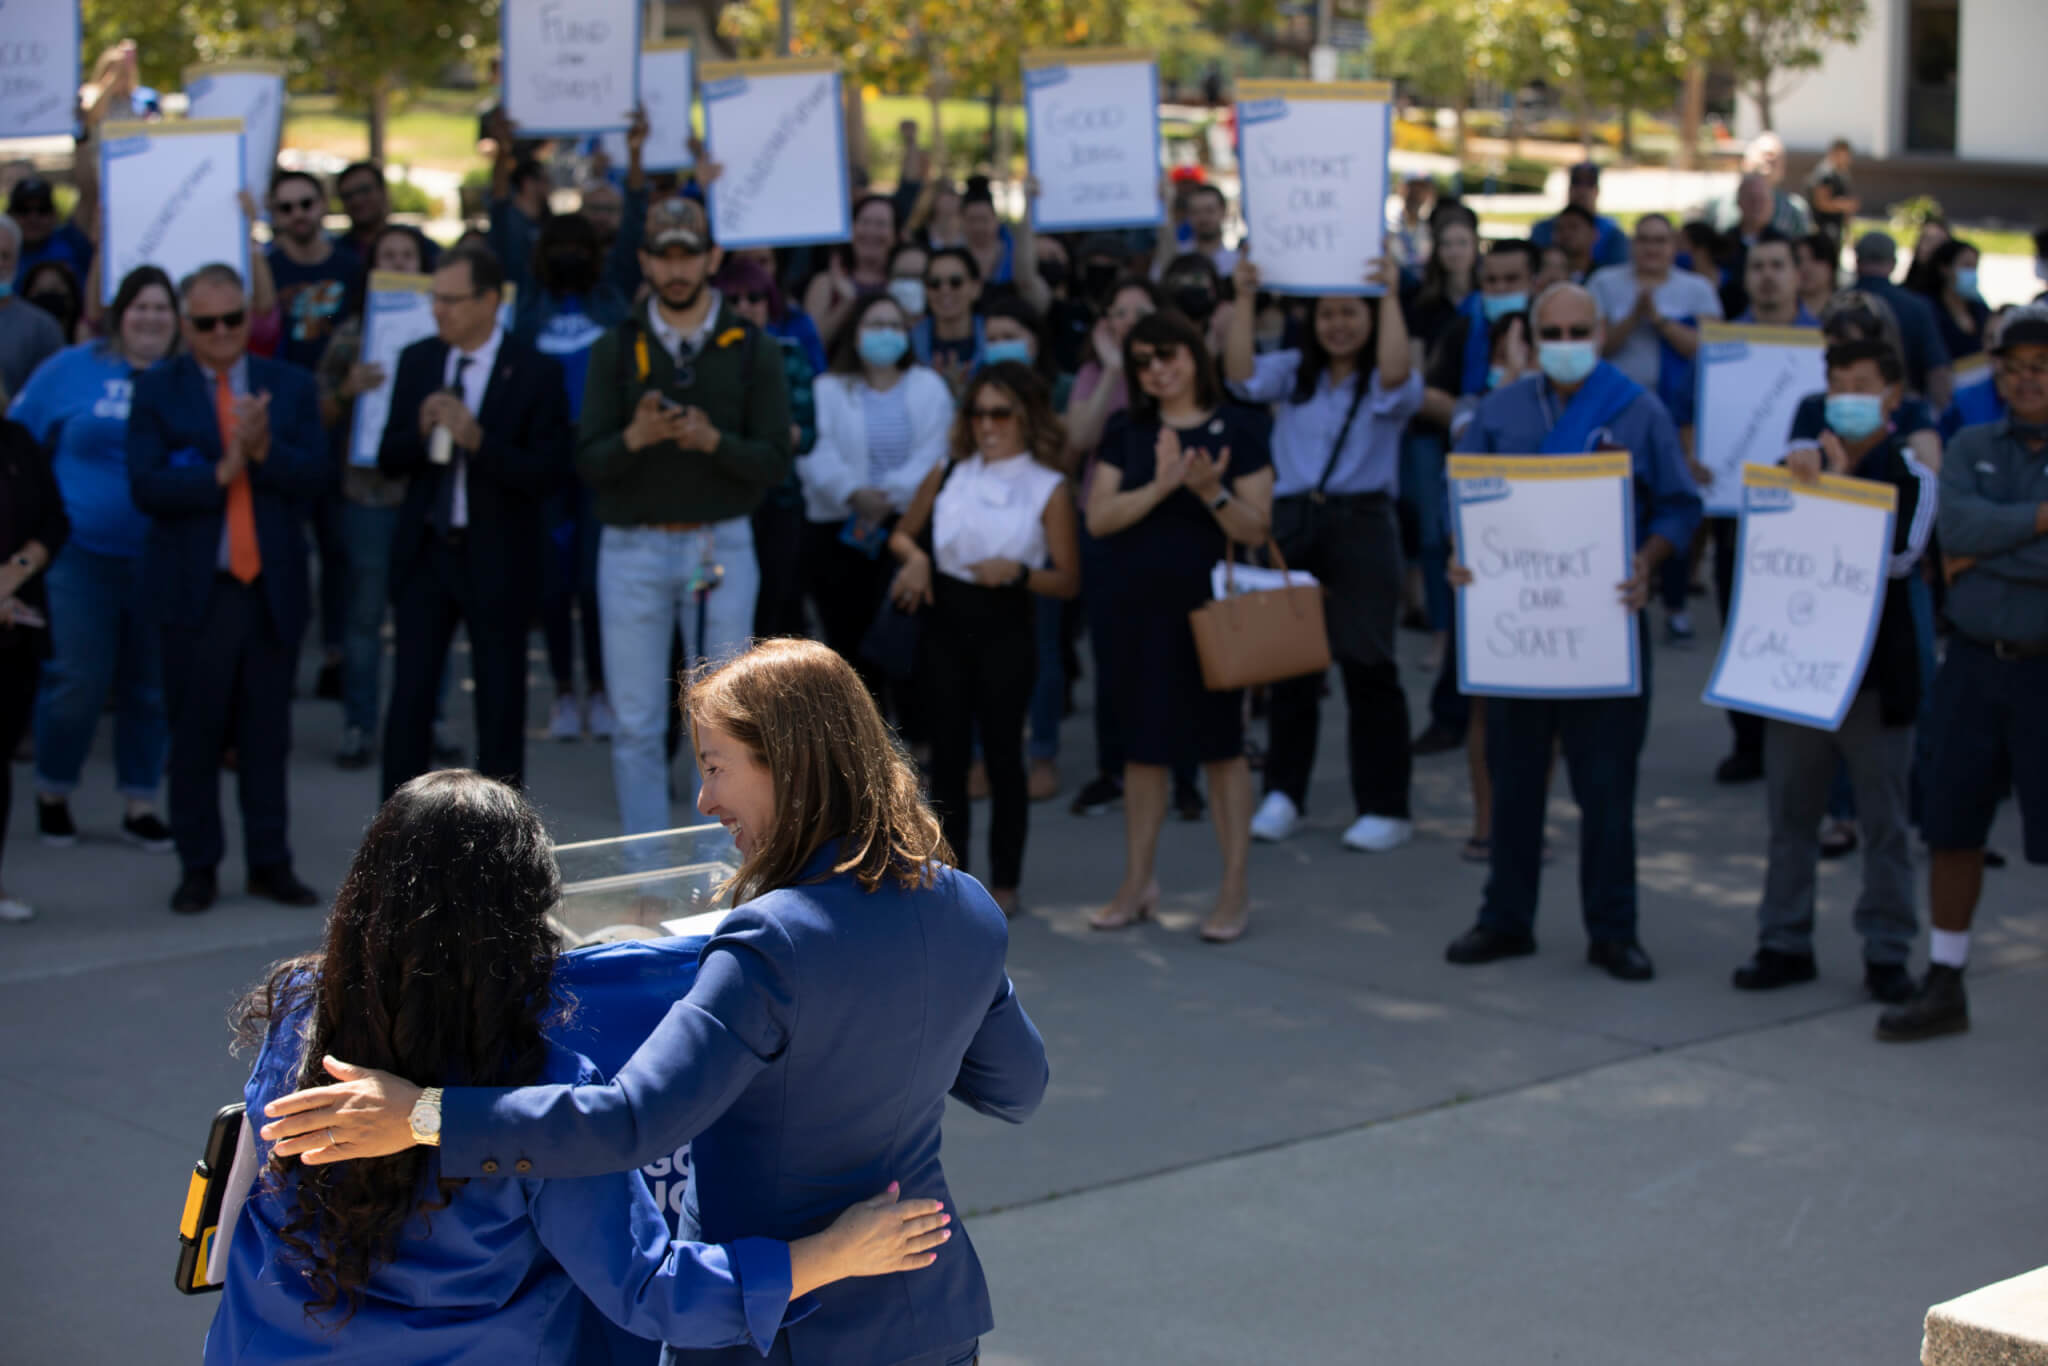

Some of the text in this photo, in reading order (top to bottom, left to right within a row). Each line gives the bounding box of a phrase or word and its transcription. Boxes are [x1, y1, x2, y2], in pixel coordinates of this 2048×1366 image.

[1044, 98, 1130, 134] GOOD
[1255, 134, 1360, 181] SUPPORT
[1287, 186, 1338, 212] OUR
[1262, 214, 1342, 255] STAFF
[1477, 525, 1600, 581] SUPPORT
[1749, 532, 1872, 596] GOOD JOBS
[1518, 585, 1566, 613] OUR
[1786, 590, 1816, 627] @
[1486, 611, 1586, 661] STAFF
[1771, 660, 1849, 696] STATE
